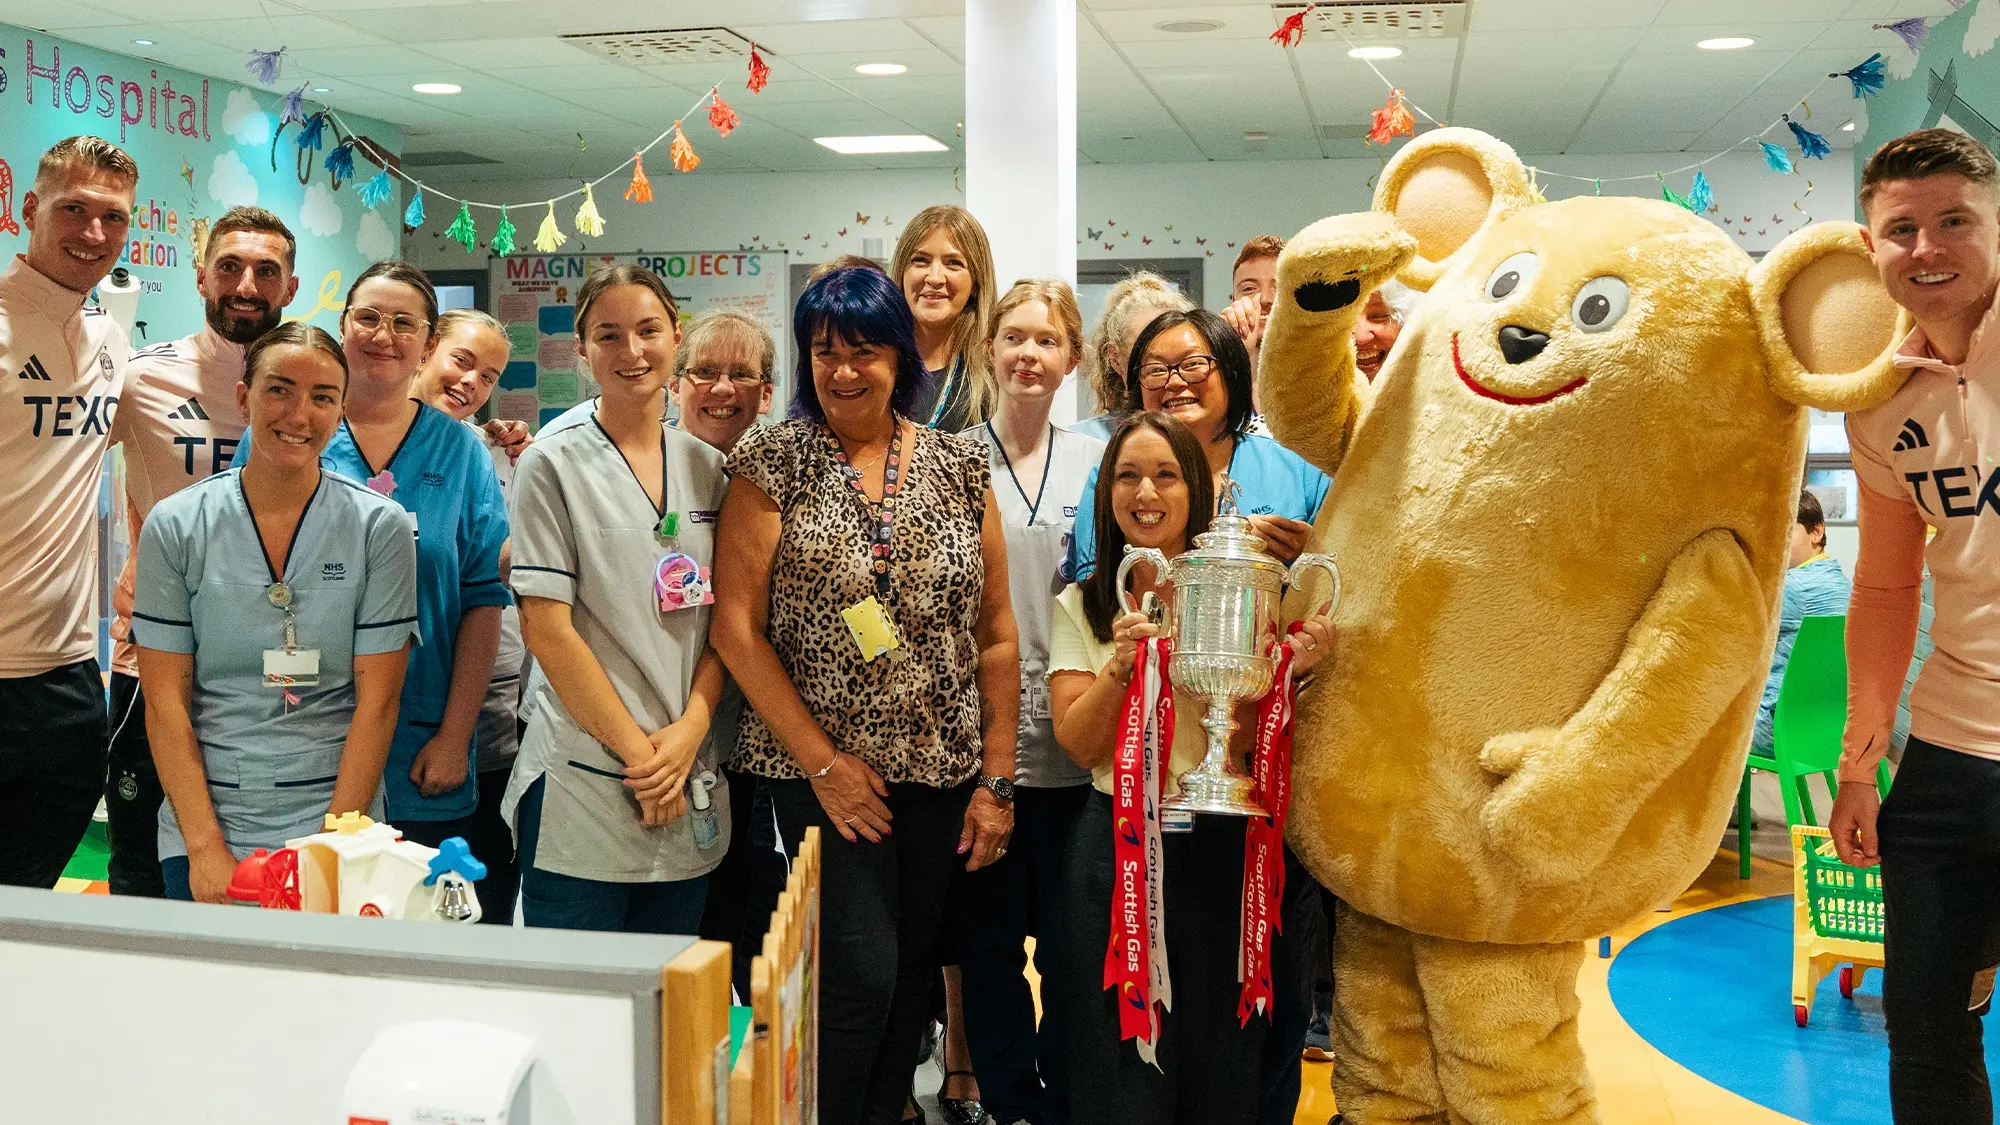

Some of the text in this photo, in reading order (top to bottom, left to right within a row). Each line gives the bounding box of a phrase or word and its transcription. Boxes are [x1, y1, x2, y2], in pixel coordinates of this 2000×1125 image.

[27, 39, 211, 144] Hospital
[129, 198, 178, 234] rchie
[120, 235, 178, 267] dation
[638, 254, 761, 278] PROJECTS
[147, 280, 162, 294] you
[174, 437, 239, 475] TE
[1251, 505, 1271, 514] NHS
[324, 563, 344, 571] NHS
[1121, 772, 1135, 808] Gas
[1260, 759, 1269, 793] Gas
[1256, 843, 1268, 953] Scottish Gas
[1124, 860, 1140, 973] Scottish Gas
[1247, 948, 1255, 979] Gas
